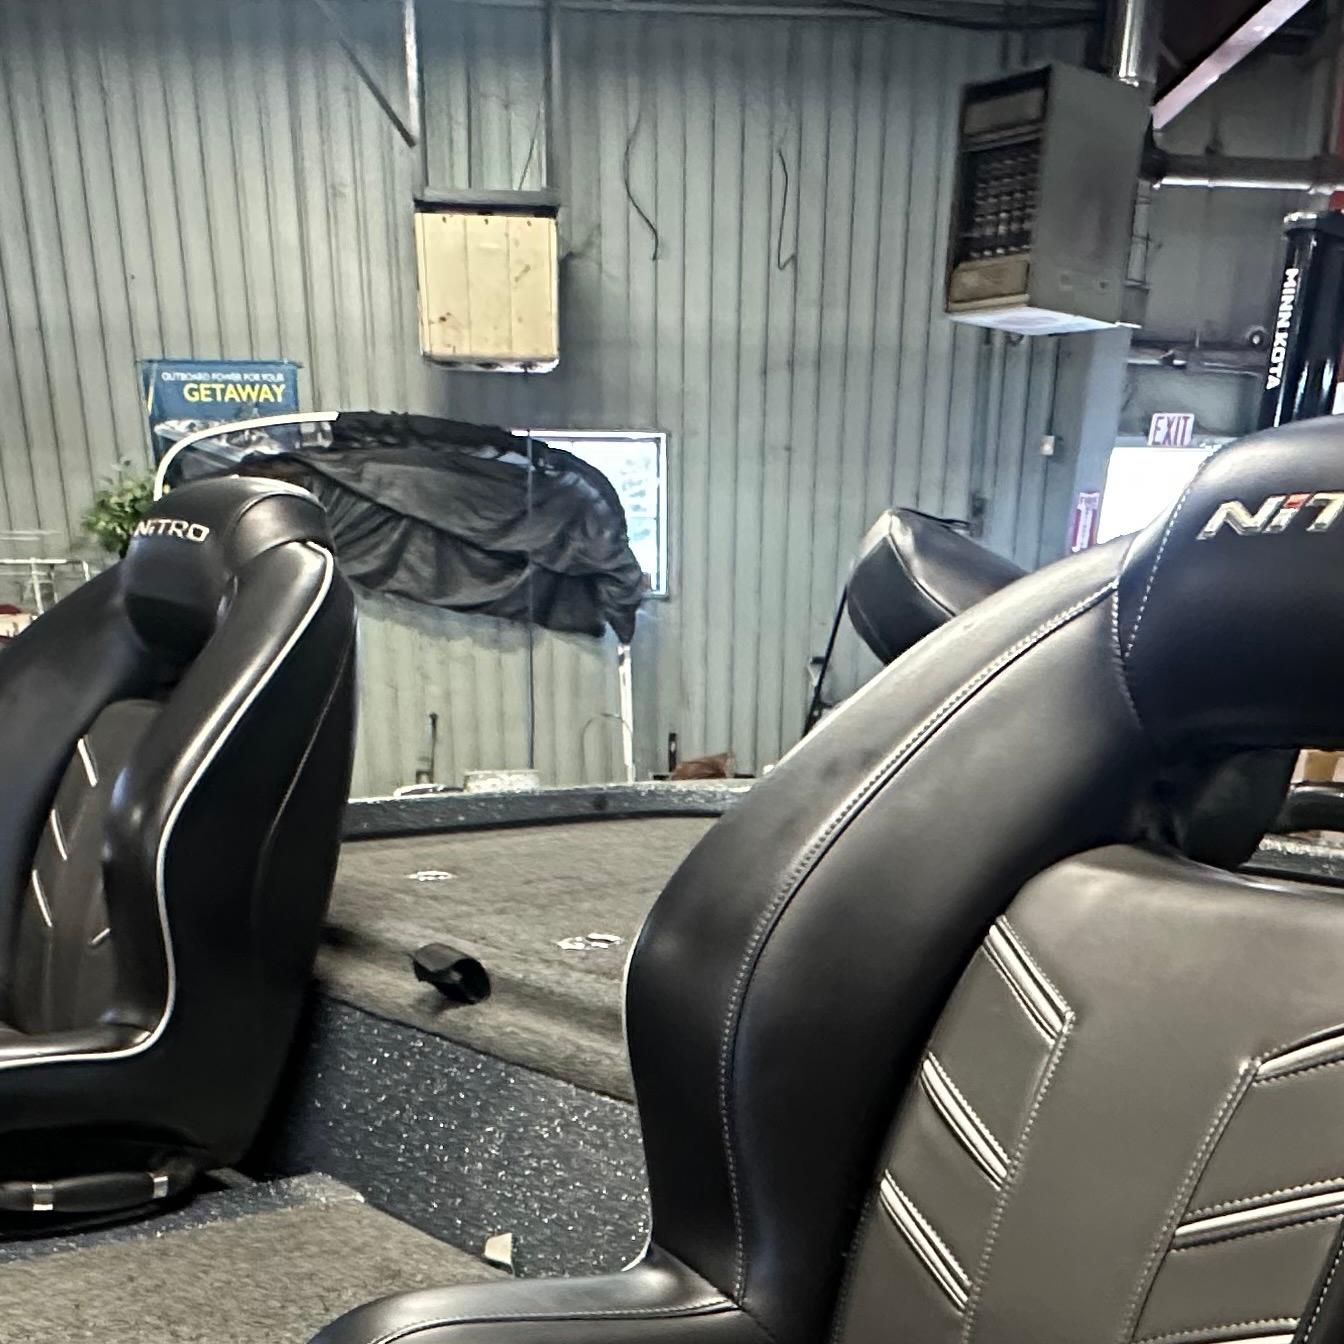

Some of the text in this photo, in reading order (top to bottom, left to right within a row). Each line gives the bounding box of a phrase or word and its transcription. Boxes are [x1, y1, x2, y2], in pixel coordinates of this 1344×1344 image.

[1266, 267, 1299, 390] MINN KOTA
[183, 382, 286, 403] GETAWAY
[1151, 415, 1191, 446] EXIT
